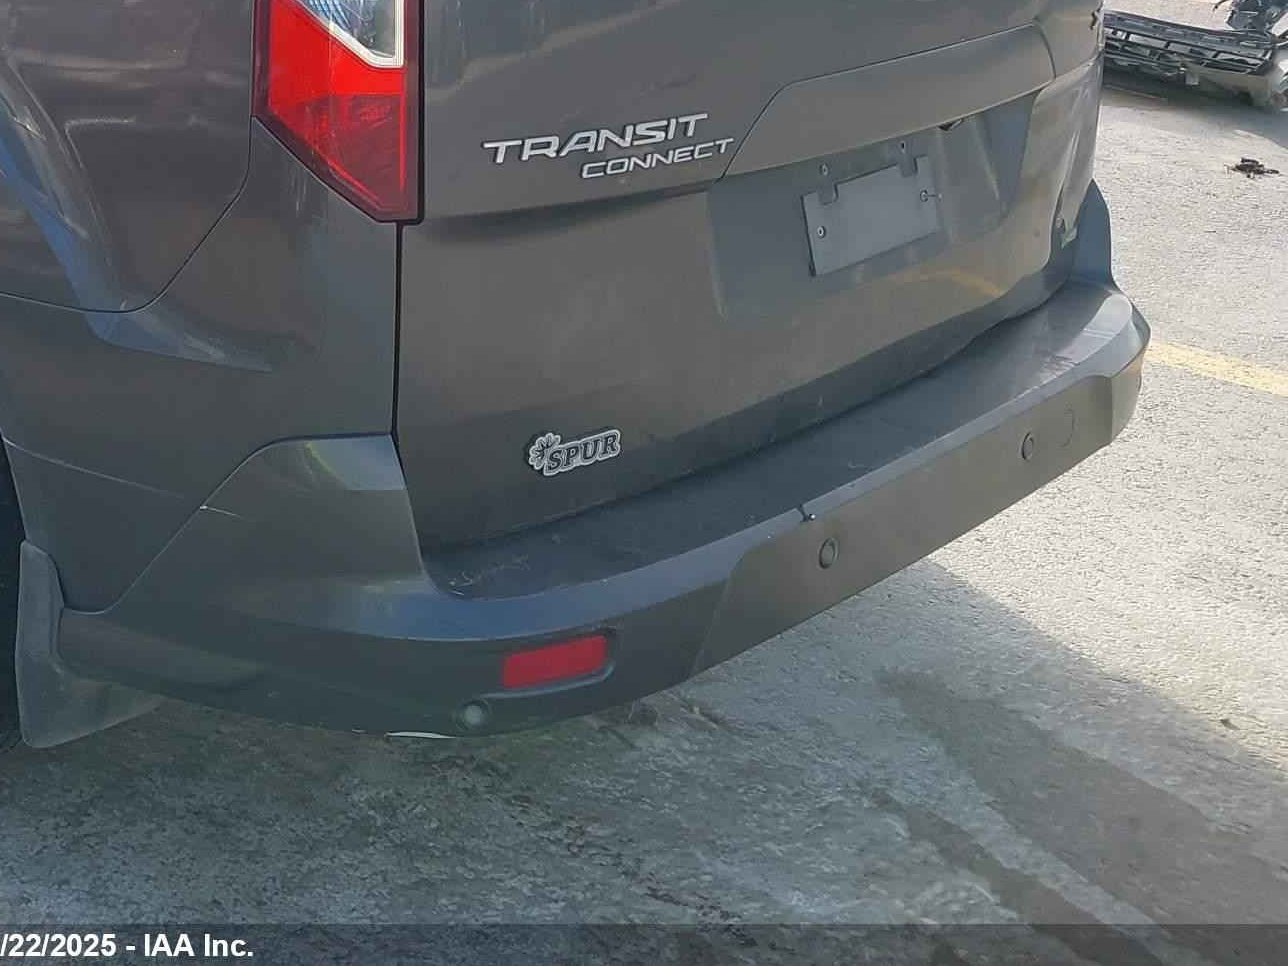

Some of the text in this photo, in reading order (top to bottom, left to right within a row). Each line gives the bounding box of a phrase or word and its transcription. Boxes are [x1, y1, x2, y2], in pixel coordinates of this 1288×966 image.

[483, 112, 709, 164] TRANSIT
[581, 137, 735, 179] CONNECT
[547, 433, 618, 471] SPUR
